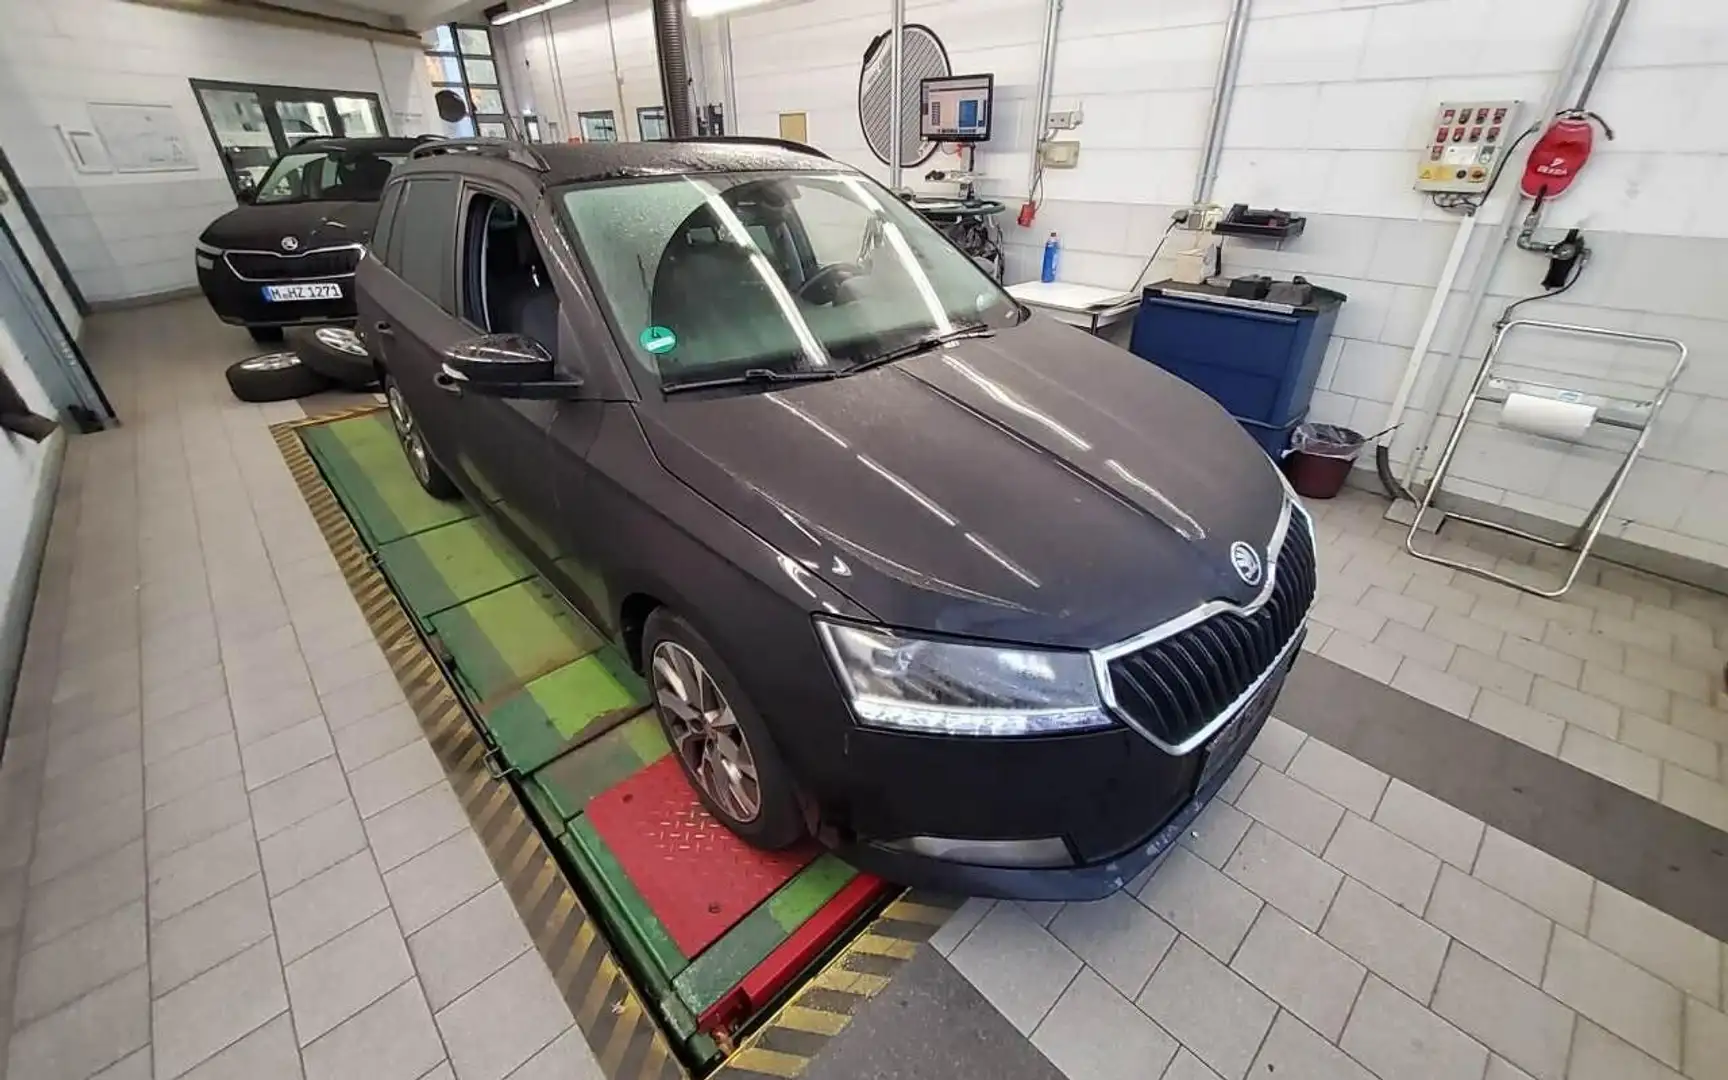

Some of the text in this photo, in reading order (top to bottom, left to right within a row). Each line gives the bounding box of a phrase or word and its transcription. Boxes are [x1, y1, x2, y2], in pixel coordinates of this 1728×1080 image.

[271, 285, 341, 300] M HZ 1271
